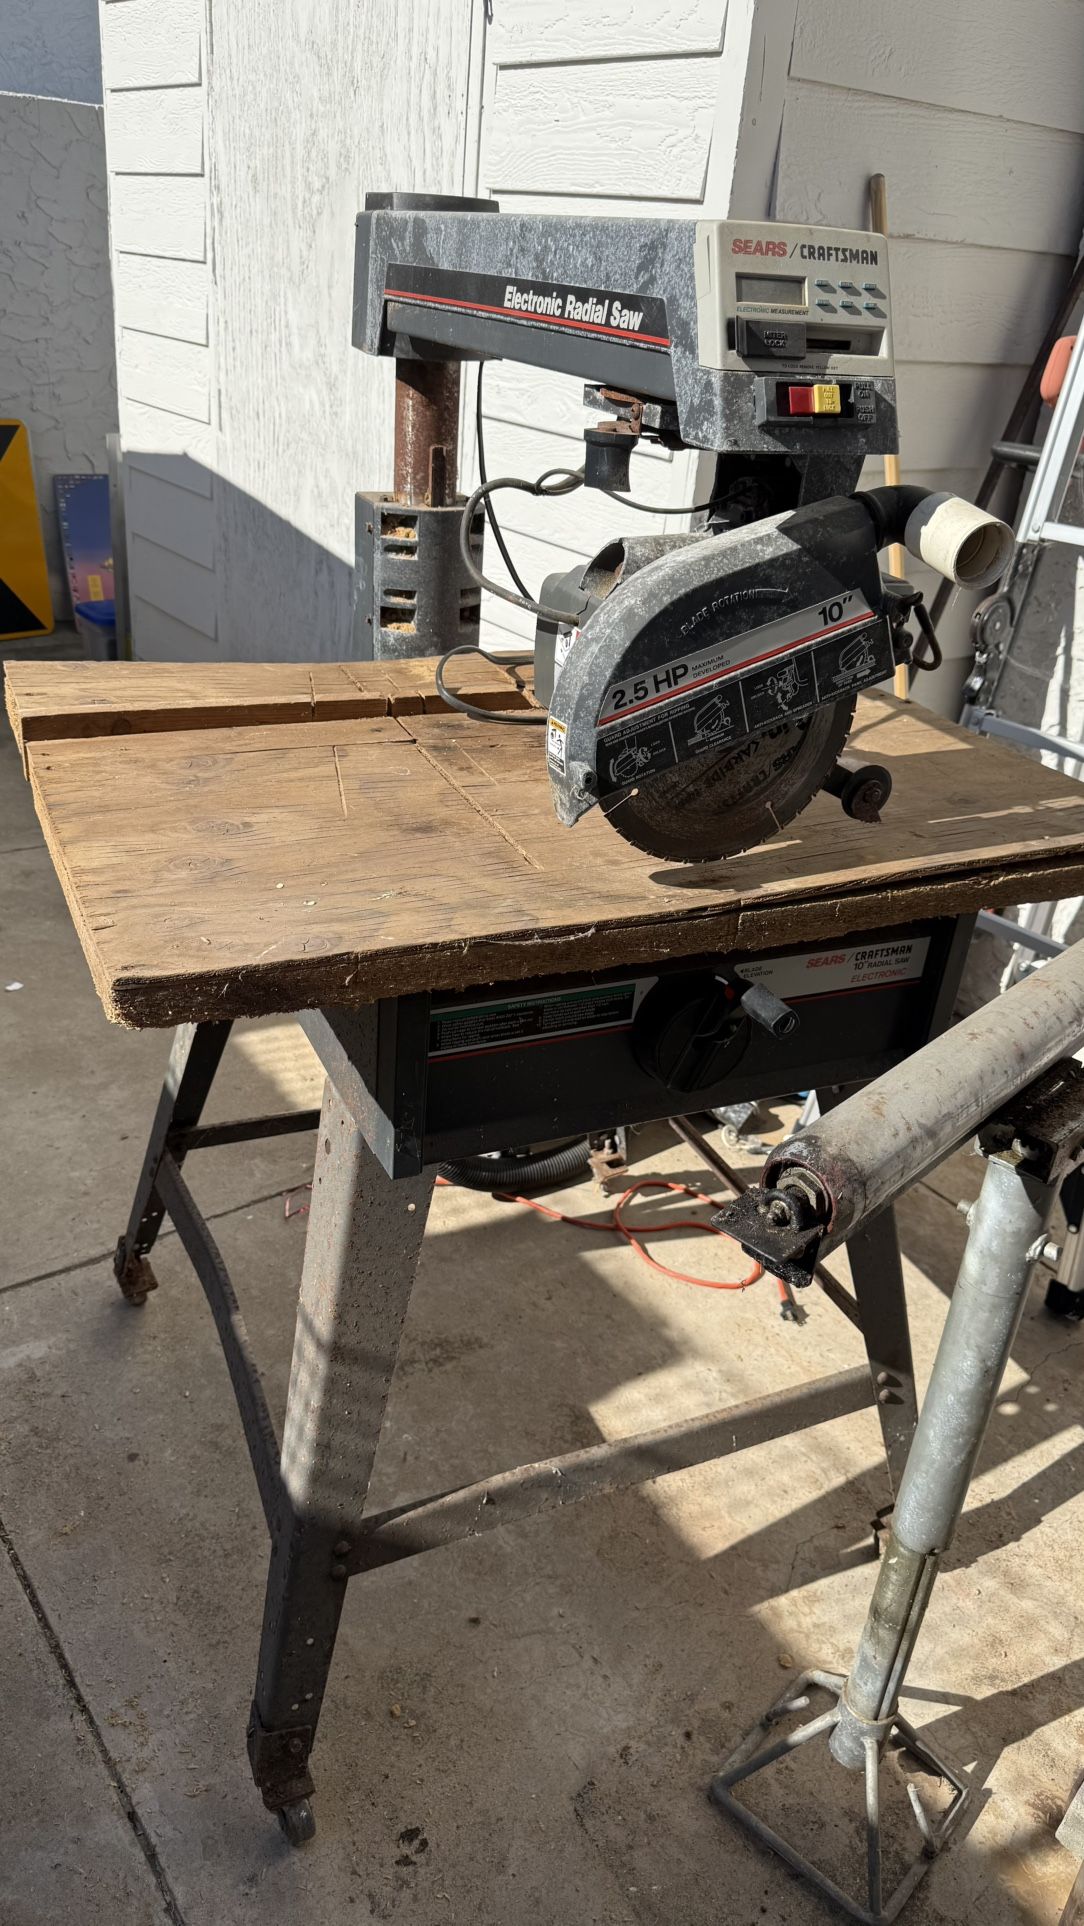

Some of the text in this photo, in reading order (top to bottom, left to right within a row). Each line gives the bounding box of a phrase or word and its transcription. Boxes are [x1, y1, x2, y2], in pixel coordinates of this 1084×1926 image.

[732, 238, 788, 258] SEARS
[800, 244, 878, 266] CRAFTSMAN
[503, 285, 644, 331] Electronic Radial Saw
[736, 306, 809, 316] ELECTRONIC MEASUREMENT
[680, 588, 757, 636] BLADE ROTATION
[691, 655, 725, 672] MAXIMUM
[692, 659, 731, 679] DEVELOPED
[612, 663, 689, 710] 2.5 HP
[603, 732, 622, 743] GUARD
[657, 711, 668, 721] FOR
[669, 703, 690, 715] RIPPING
[806, 953, 846, 969] SEARS
[855, 944, 913, 962] CRAFTSMAN
[867, 958, 893, 969] RADIAL
[894, 956, 911, 966] SAW
[743, 969, 774, 979] ELEVATION
[850, 967, 907, 983] ELECTRONIC
